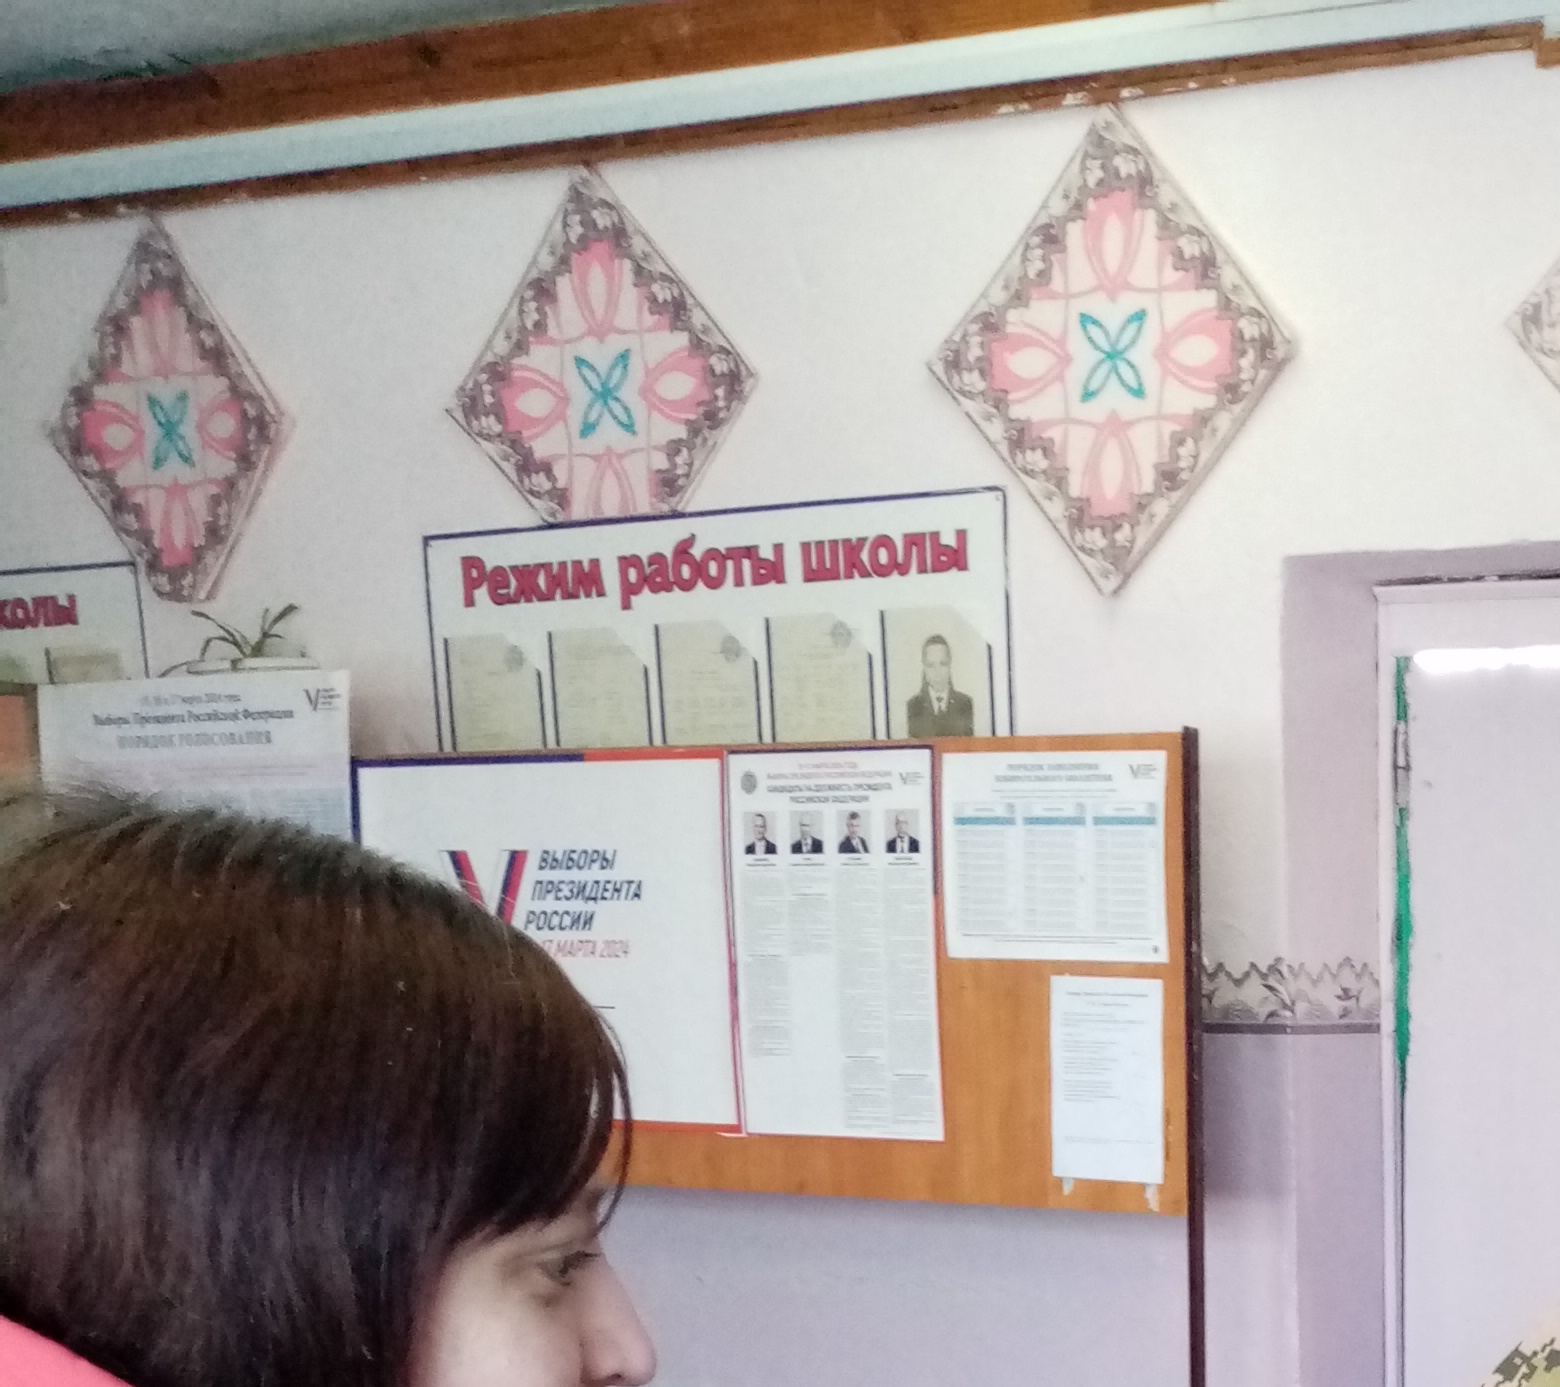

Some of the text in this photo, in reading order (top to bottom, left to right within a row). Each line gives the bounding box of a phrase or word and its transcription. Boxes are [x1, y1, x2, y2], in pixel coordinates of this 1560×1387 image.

[460, 528, 969, 610] Режим работы школы
[538, 849, 617, 871] ВЫБОРЫ
[530, 879, 643, 904] ПРЕЗИДЕНТА
[523, 910, 596, 931] РОССИИ
